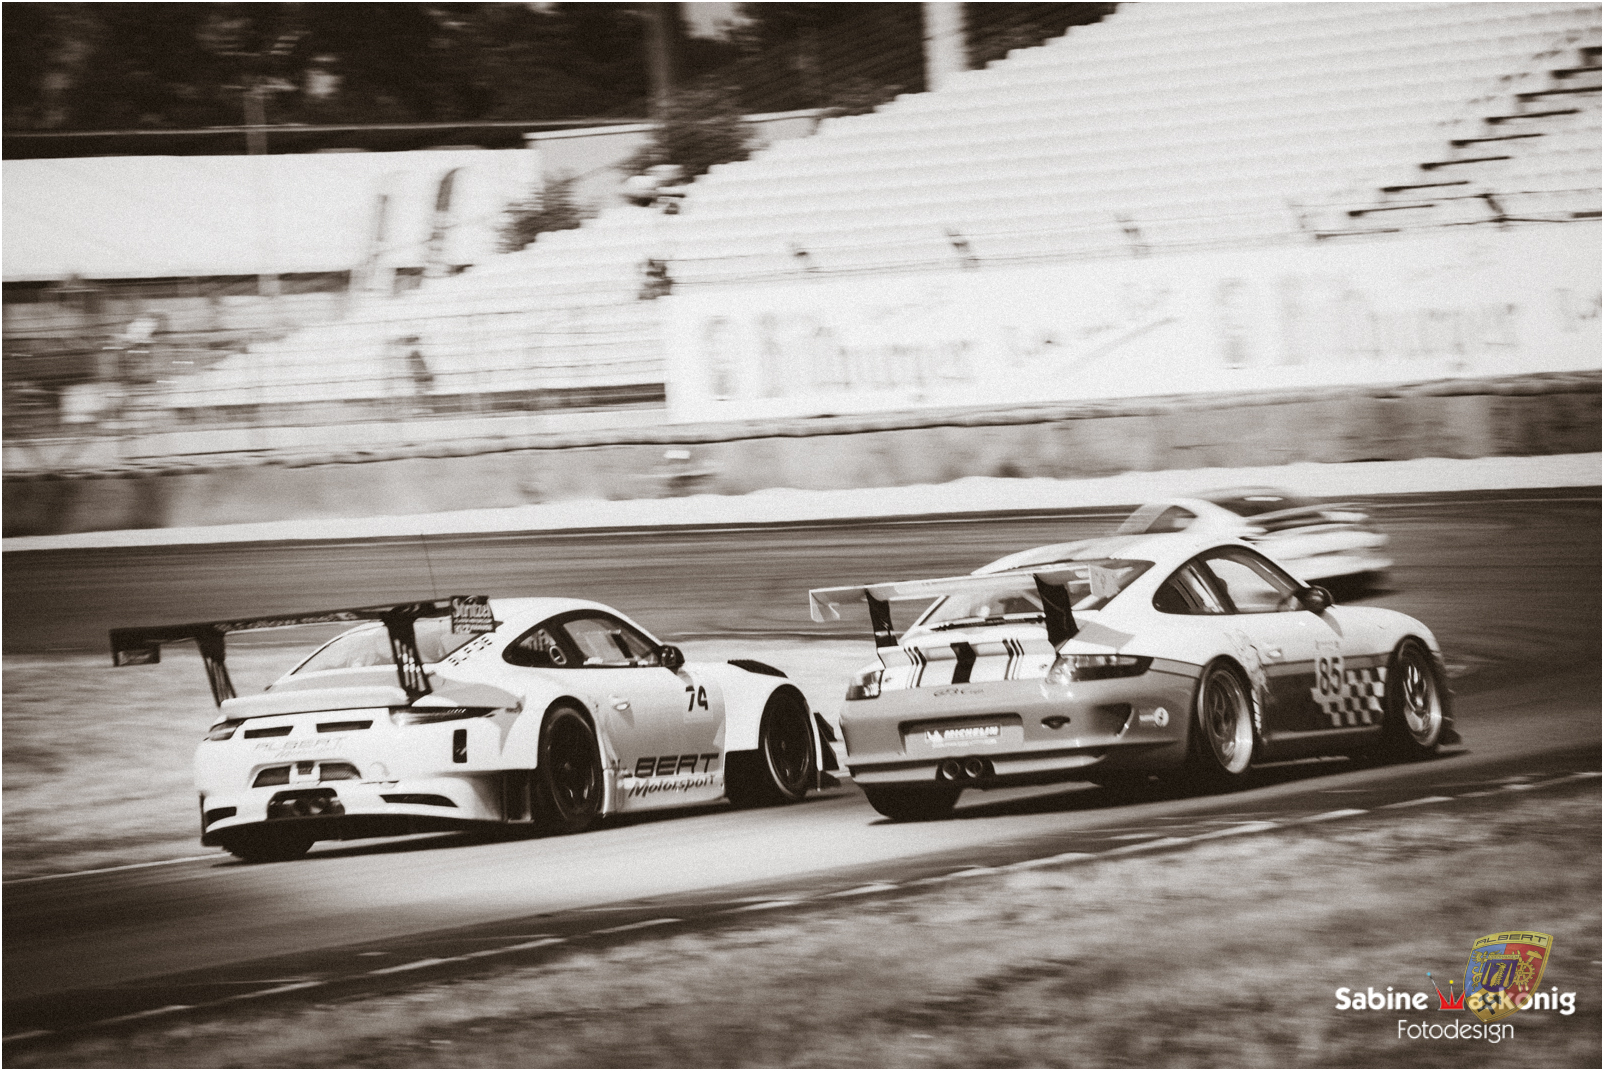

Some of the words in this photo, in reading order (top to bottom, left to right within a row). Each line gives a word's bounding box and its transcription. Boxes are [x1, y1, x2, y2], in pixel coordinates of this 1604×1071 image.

[1319, 656, 1341, 696] 85
[685, 685, 709, 711] 74
[943, 725, 999, 739] MICHELIN
[628, 774, 717, 798] Motorsport
